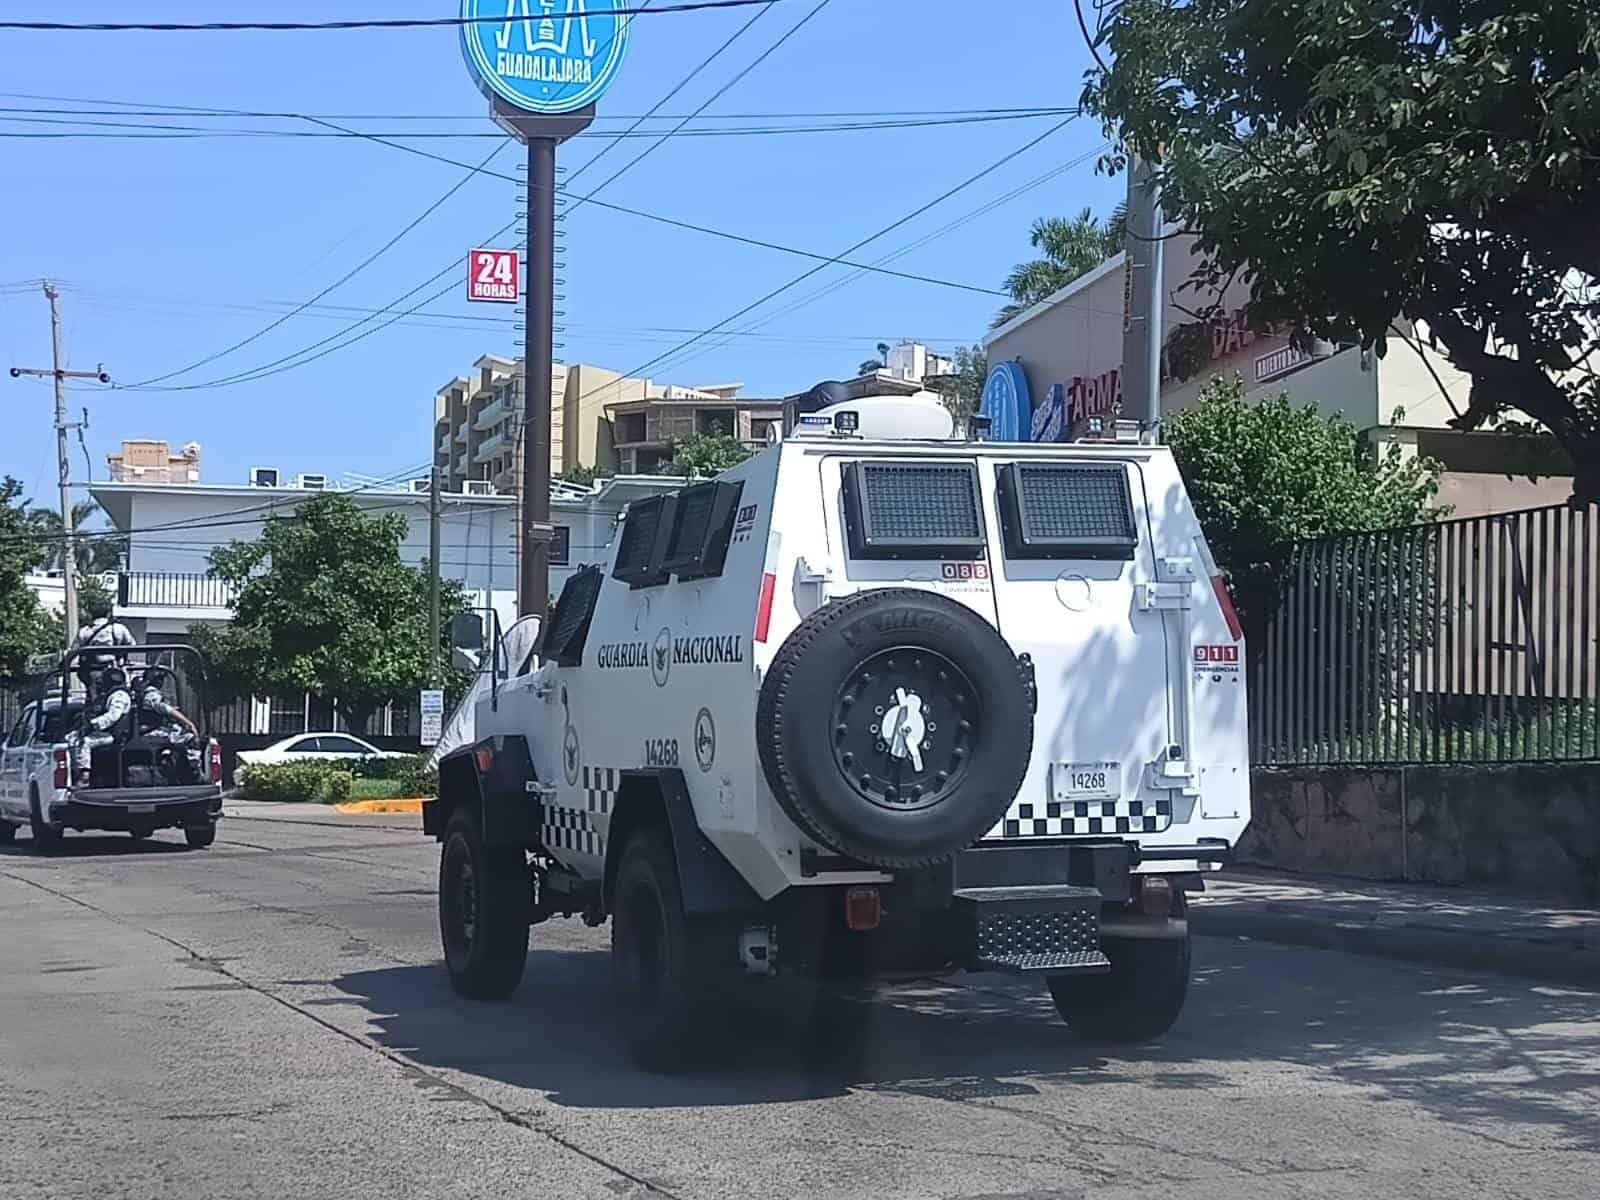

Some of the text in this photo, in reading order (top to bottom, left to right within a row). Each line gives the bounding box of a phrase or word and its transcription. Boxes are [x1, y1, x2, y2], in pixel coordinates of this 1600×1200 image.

[497, 52, 592, 83] GUADALAJARA
[477, 254, 512, 283] 24
[474, 283, 515, 298] HORAS
[1064, 369, 1121, 425] FARMA
[598, 635, 743, 668] GUARDIA NACIONAL
[1195, 647, 1237, 660] 911
[645, 740, 679, 765] 14268
[1071, 773, 1105, 789] 14268
